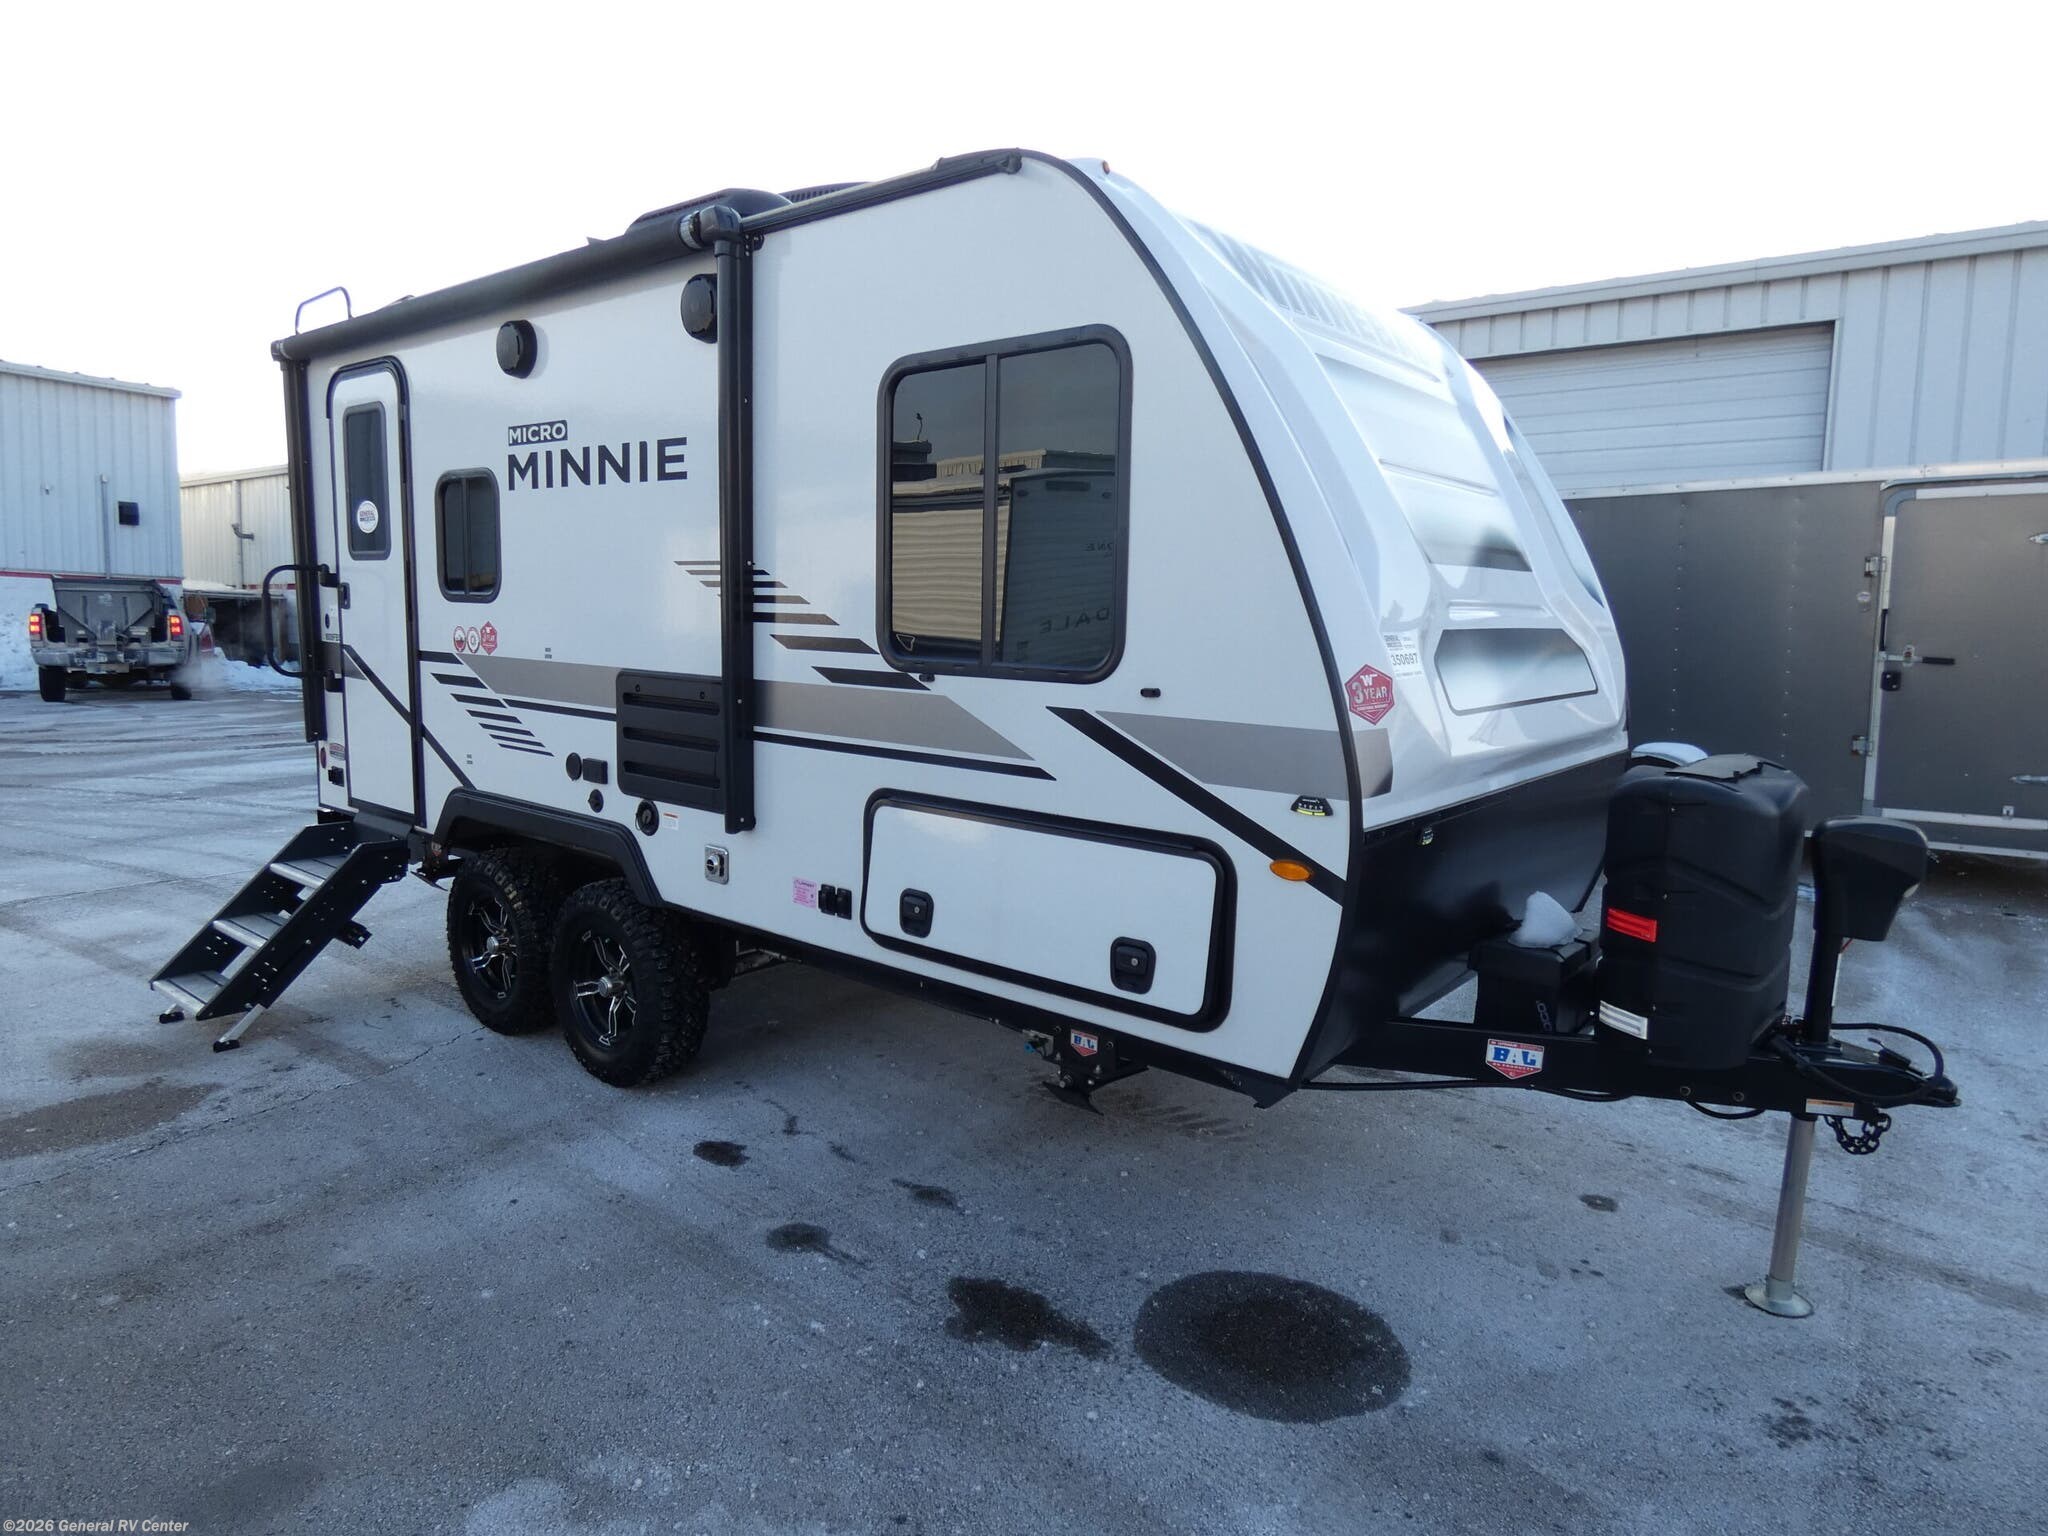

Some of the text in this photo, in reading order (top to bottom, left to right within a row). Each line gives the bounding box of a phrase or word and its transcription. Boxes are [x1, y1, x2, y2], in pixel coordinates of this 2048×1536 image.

[508, 423, 566, 444] MICRO
[508, 437, 687, 490] MINNIE
[1391, 653, 1418, 665] 350697
[1352, 681, 1388, 704] 3 YEAR
[1492, 1047, 1537, 1066] BAL
